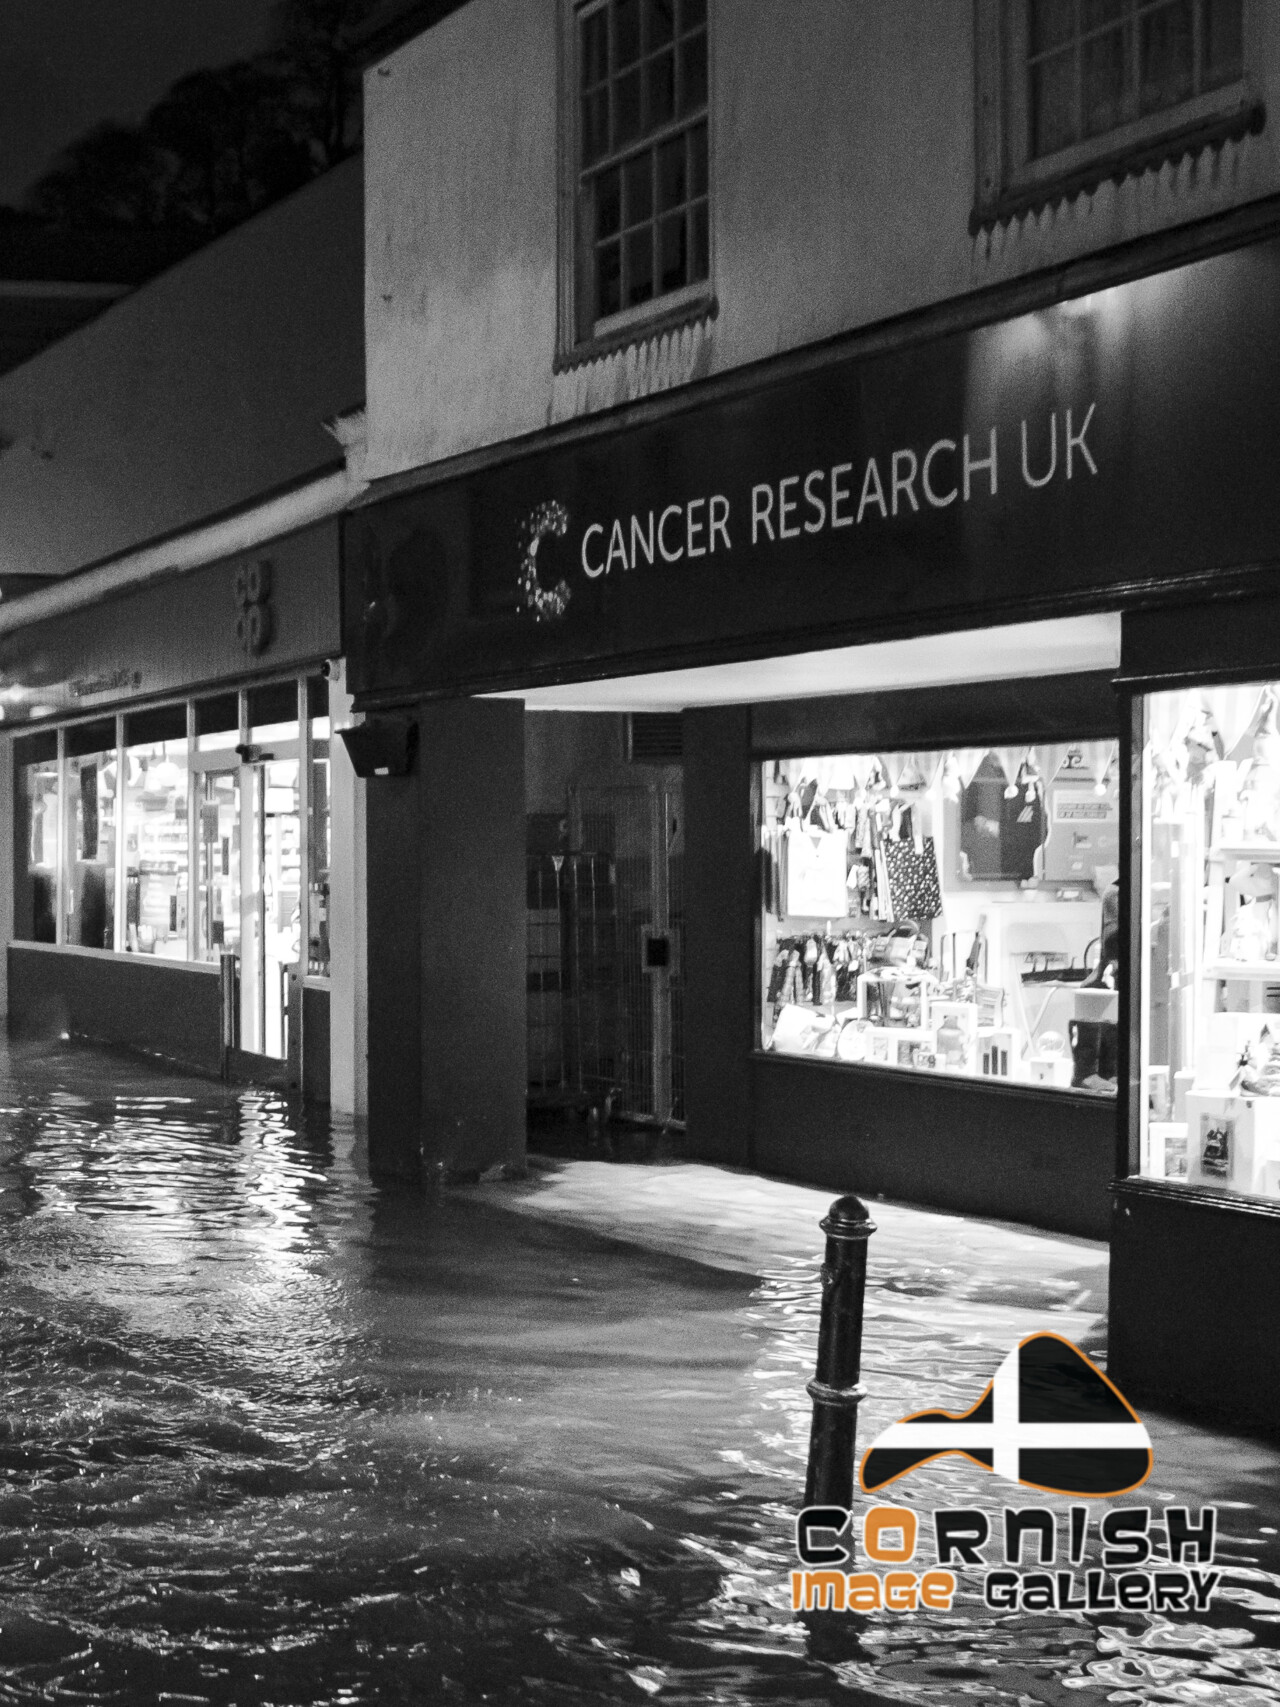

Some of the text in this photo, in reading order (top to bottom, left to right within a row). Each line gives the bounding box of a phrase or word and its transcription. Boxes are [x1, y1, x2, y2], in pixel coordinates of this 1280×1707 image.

[580, 403, 1100, 580] CANCER RESEARCH UK
